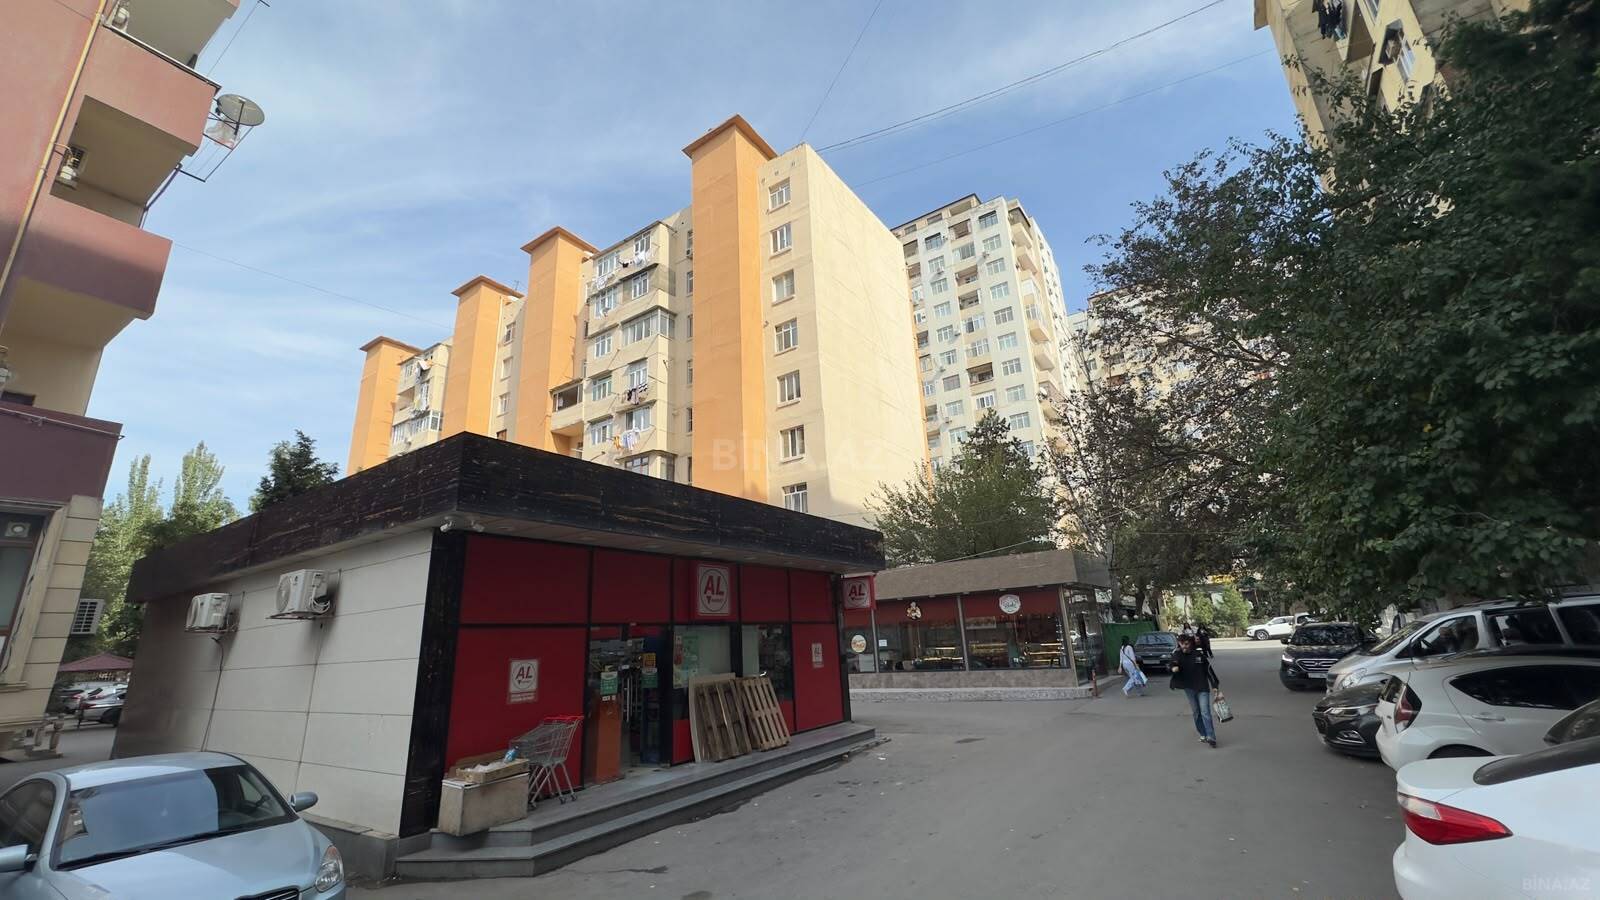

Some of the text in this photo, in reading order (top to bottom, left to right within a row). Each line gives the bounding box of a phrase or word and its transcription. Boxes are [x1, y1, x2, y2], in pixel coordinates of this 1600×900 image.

[704, 575, 725, 595] AL
[848, 584, 866, 597] AL
[515, 665, 533, 680] AL
